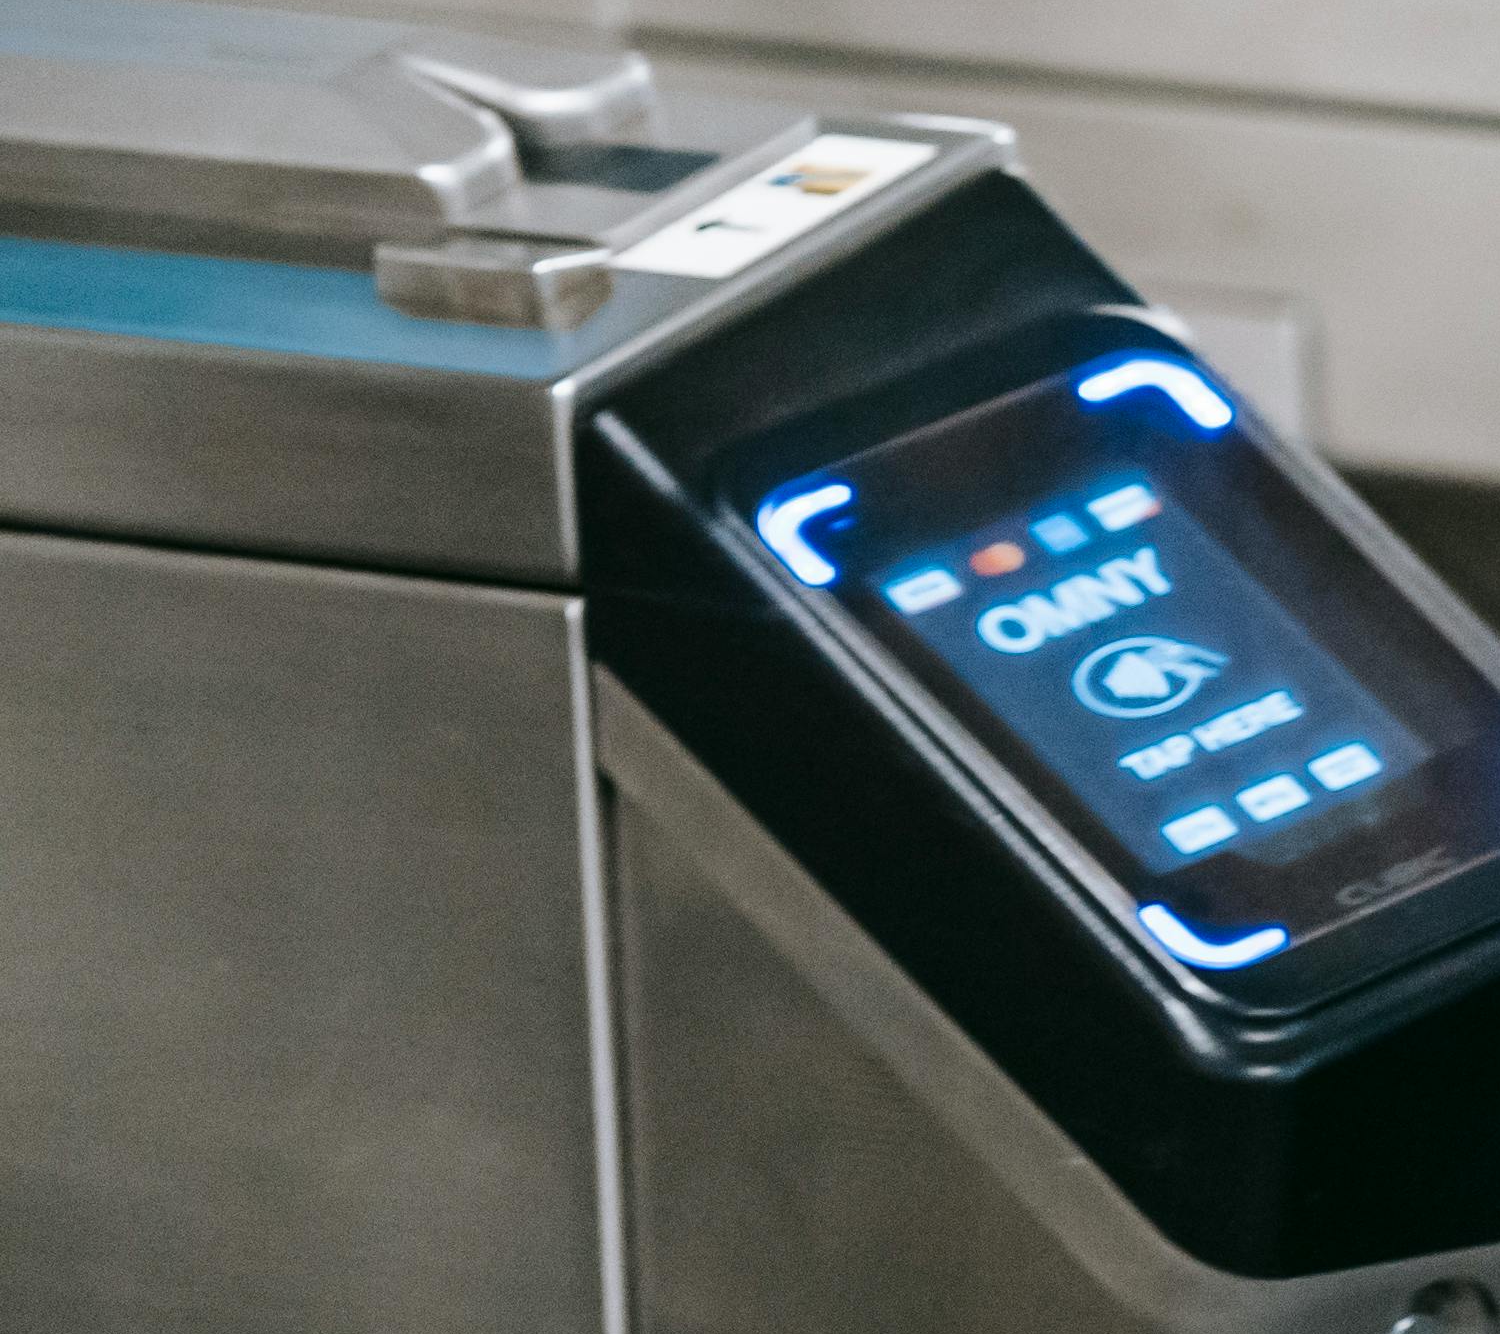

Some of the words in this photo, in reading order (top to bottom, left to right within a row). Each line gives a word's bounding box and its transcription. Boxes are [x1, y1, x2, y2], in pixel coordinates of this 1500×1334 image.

[976, 545, 1173, 653] OMNY
[1116, 733, 1195, 781] TAP
[1190, 690, 1305, 752] HERE
